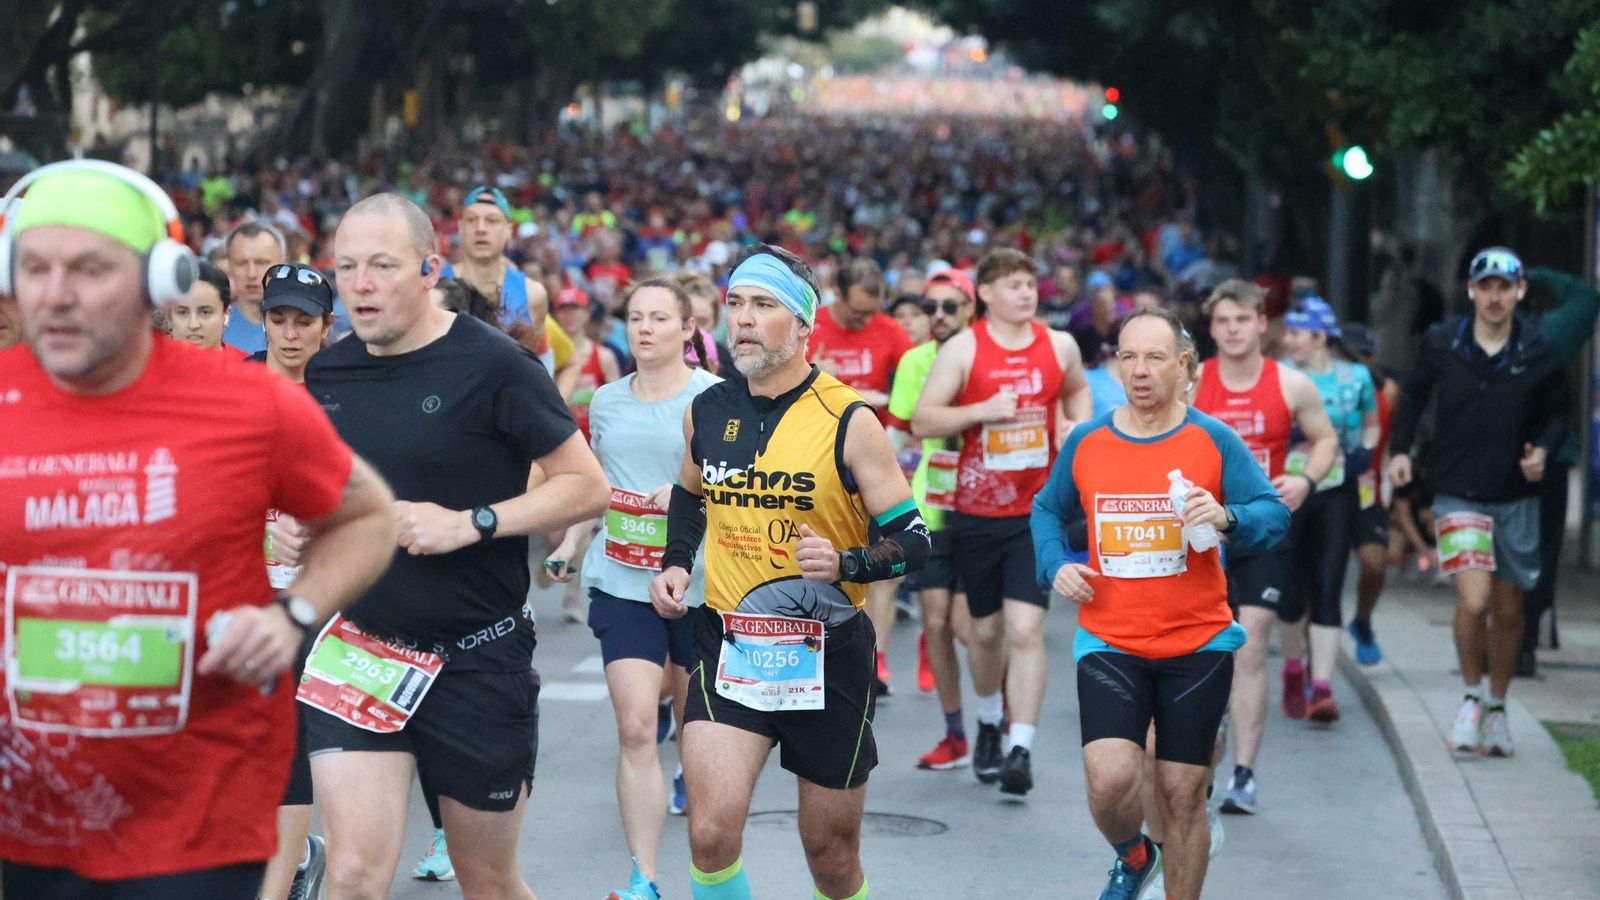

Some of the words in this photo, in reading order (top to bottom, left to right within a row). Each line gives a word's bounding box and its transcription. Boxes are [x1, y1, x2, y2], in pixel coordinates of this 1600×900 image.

[703, 459, 816, 492] bichos
[25, 489, 140, 531] MÁLAGA
[703, 488, 815, 511] runners
[620, 517, 657, 535] 3946
[1114, 526, 1165, 541] 17041
[745, 620, 815, 634] GENERALI
[55, 628, 142, 664] 3564
[340, 651, 397, 685] 2963
[745, 649, 799, 668] 10256
